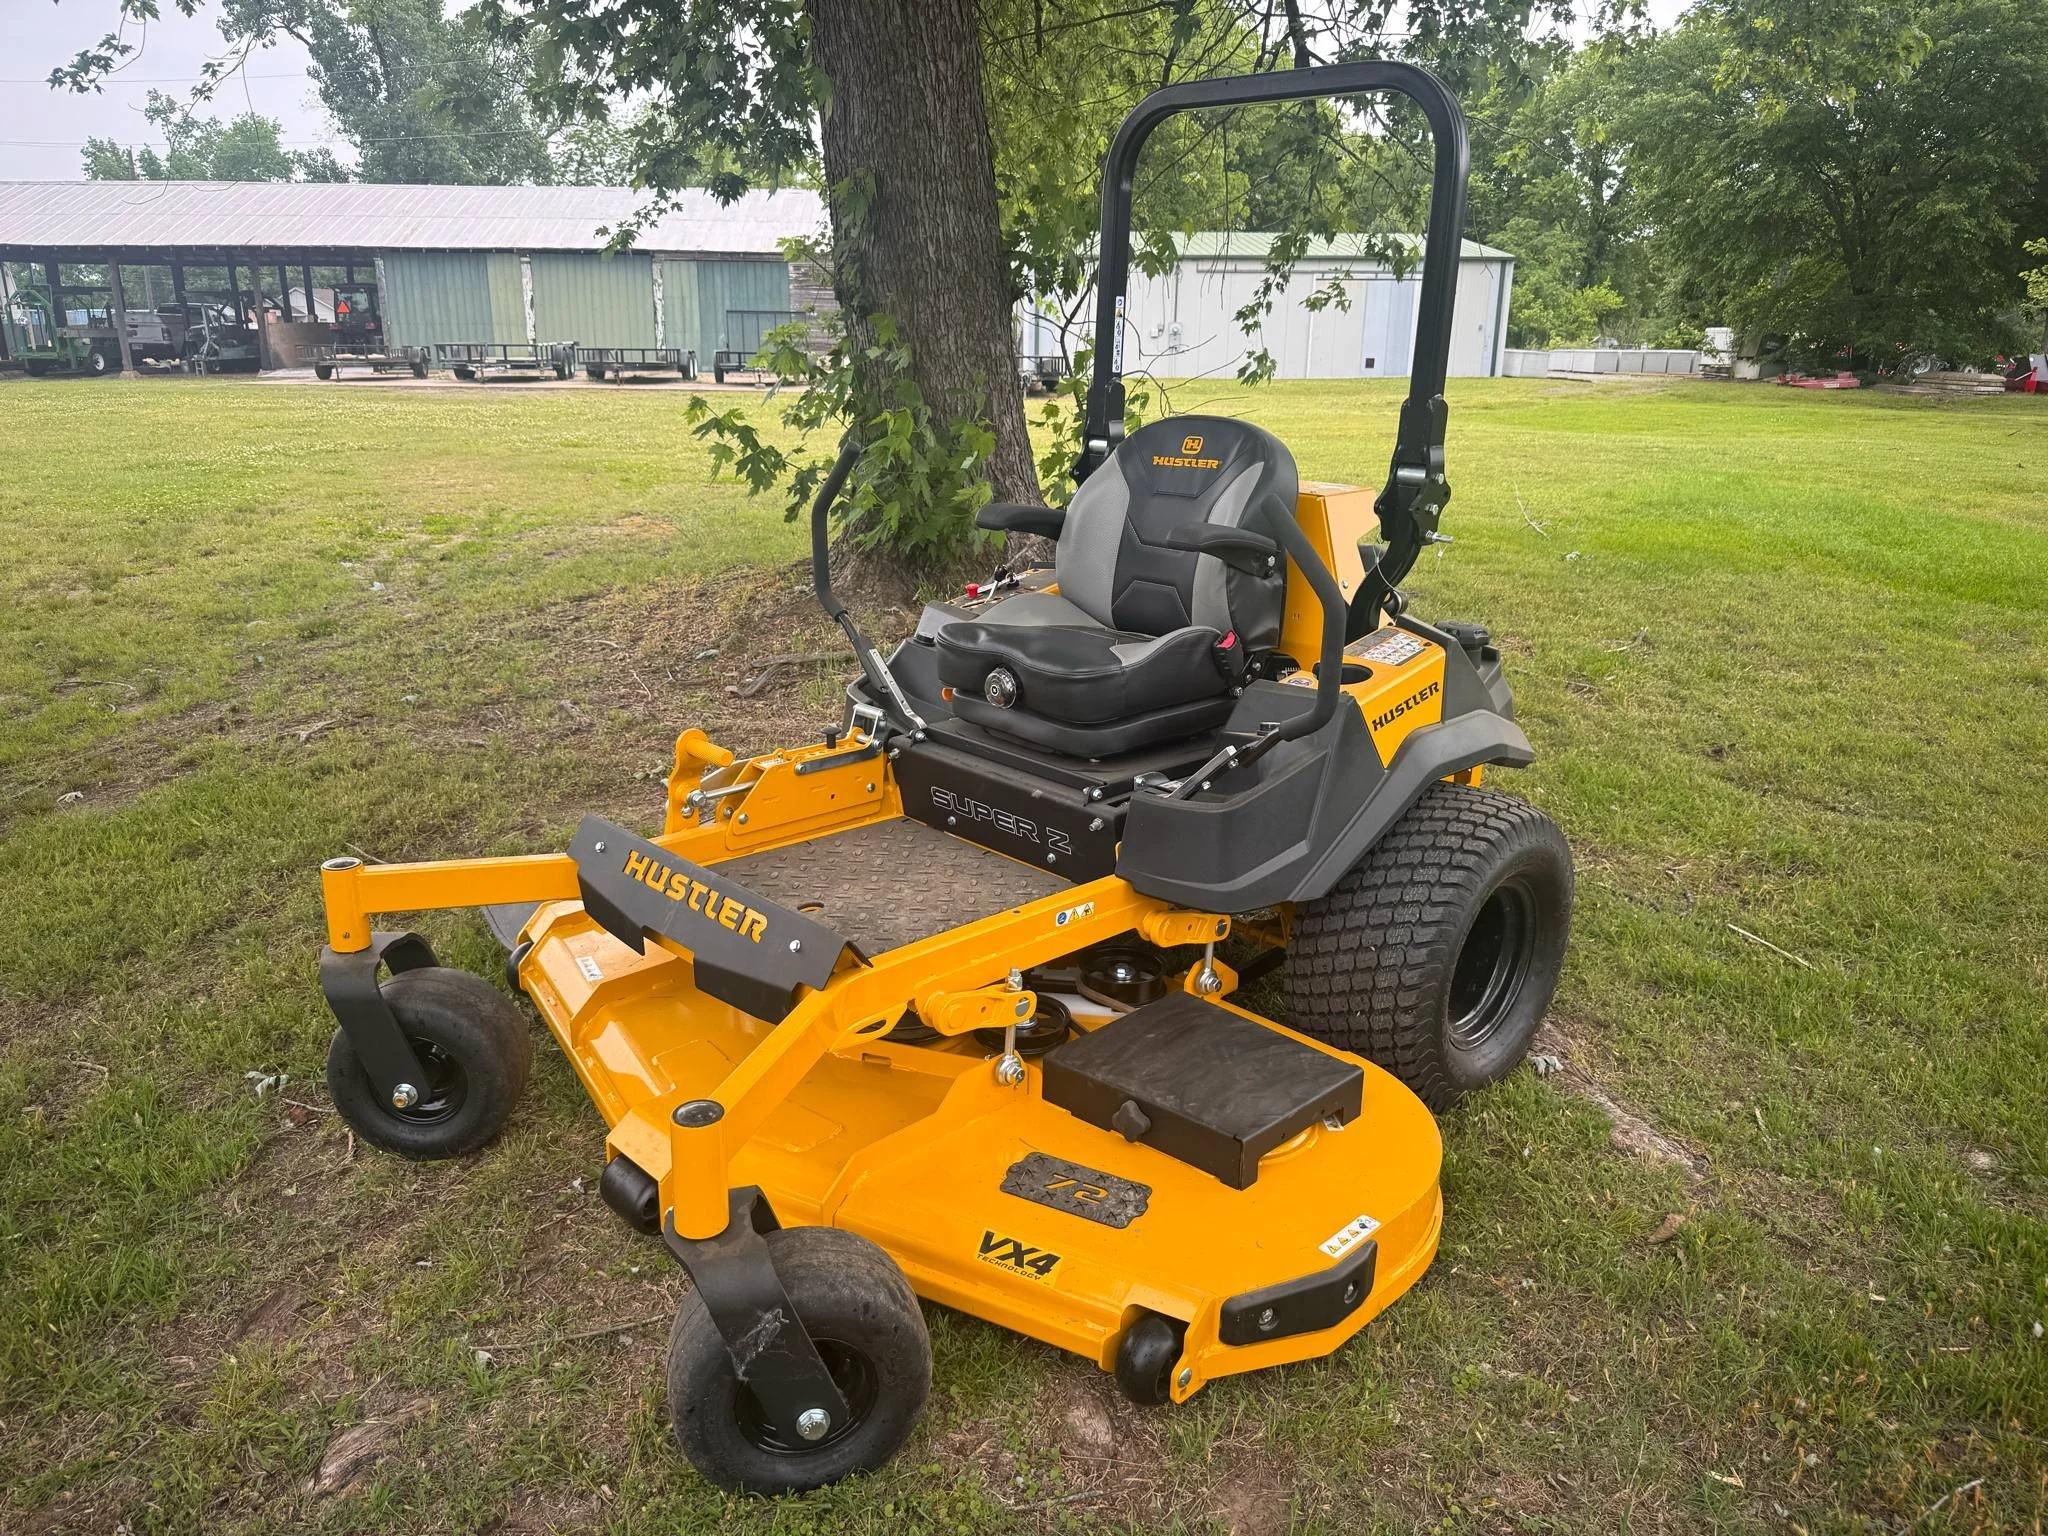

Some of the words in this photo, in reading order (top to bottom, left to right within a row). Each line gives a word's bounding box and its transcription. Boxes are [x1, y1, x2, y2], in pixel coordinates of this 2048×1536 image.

[1152, 455, 1219, 469] HUSTLER
[1371, 681, 1440, 732] HUSTLER
[931, 786, 1040, 843] SUPER
[1046, 826, 1072, 855] Z
[622, 848, 769, 944] HUSTLER
[1043, 1172, 1110, 1205] 72
[976, 1253, 1042, 1281] TECHNOLOGY
[979, 1230, 1061, 1276] VX4
